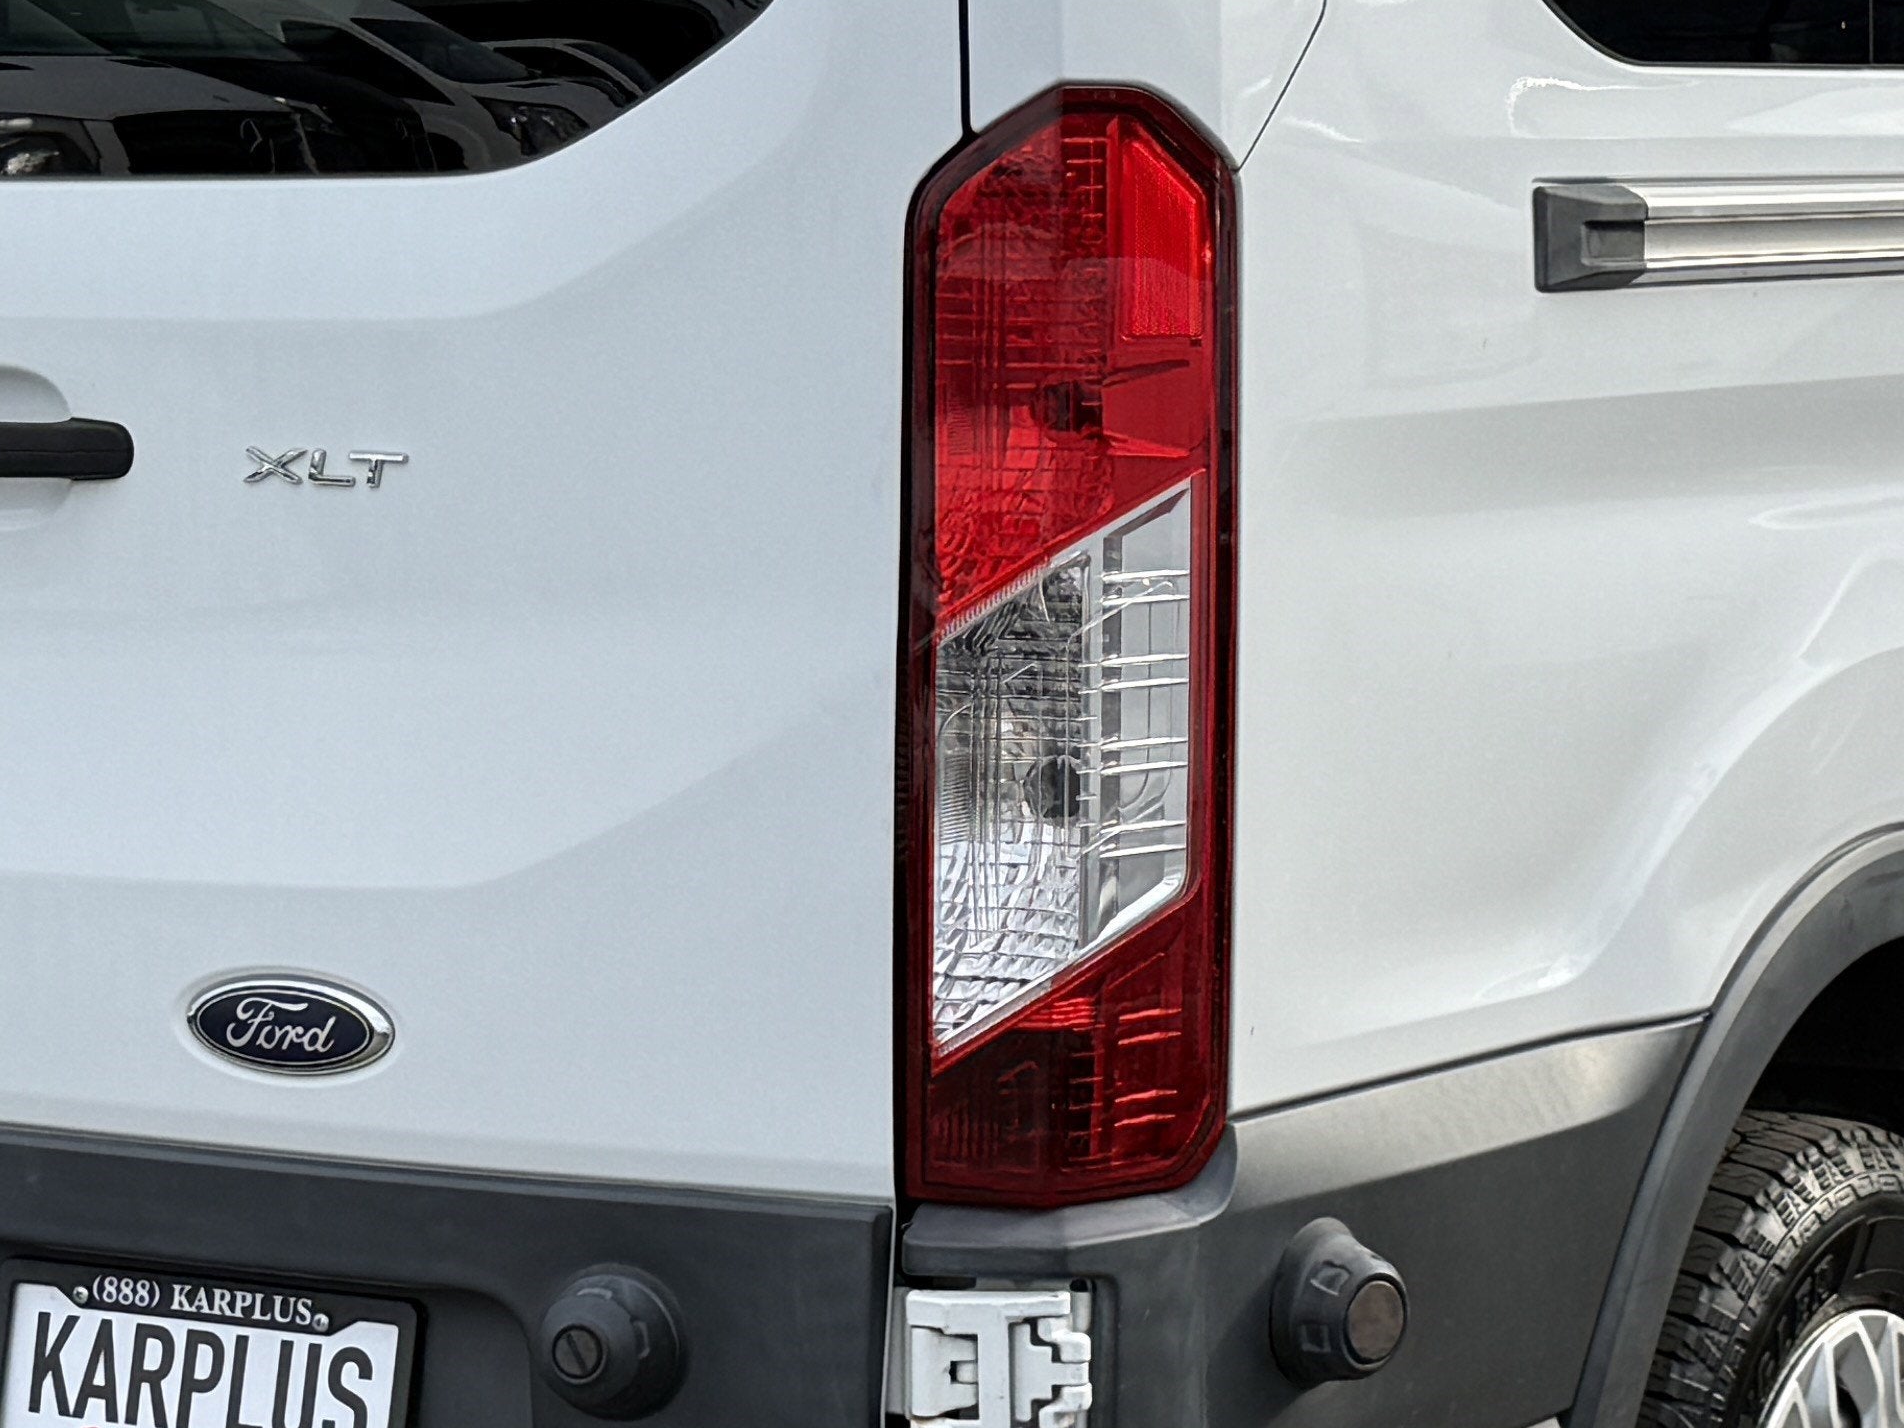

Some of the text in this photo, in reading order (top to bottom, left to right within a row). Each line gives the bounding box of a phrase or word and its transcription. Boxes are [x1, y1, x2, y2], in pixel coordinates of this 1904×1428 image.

[244, 445, 409, 489] XLT
[226, 997, 336, 1053] Ford
[91, 1274, 313, 1325] (888) KARPLUS
